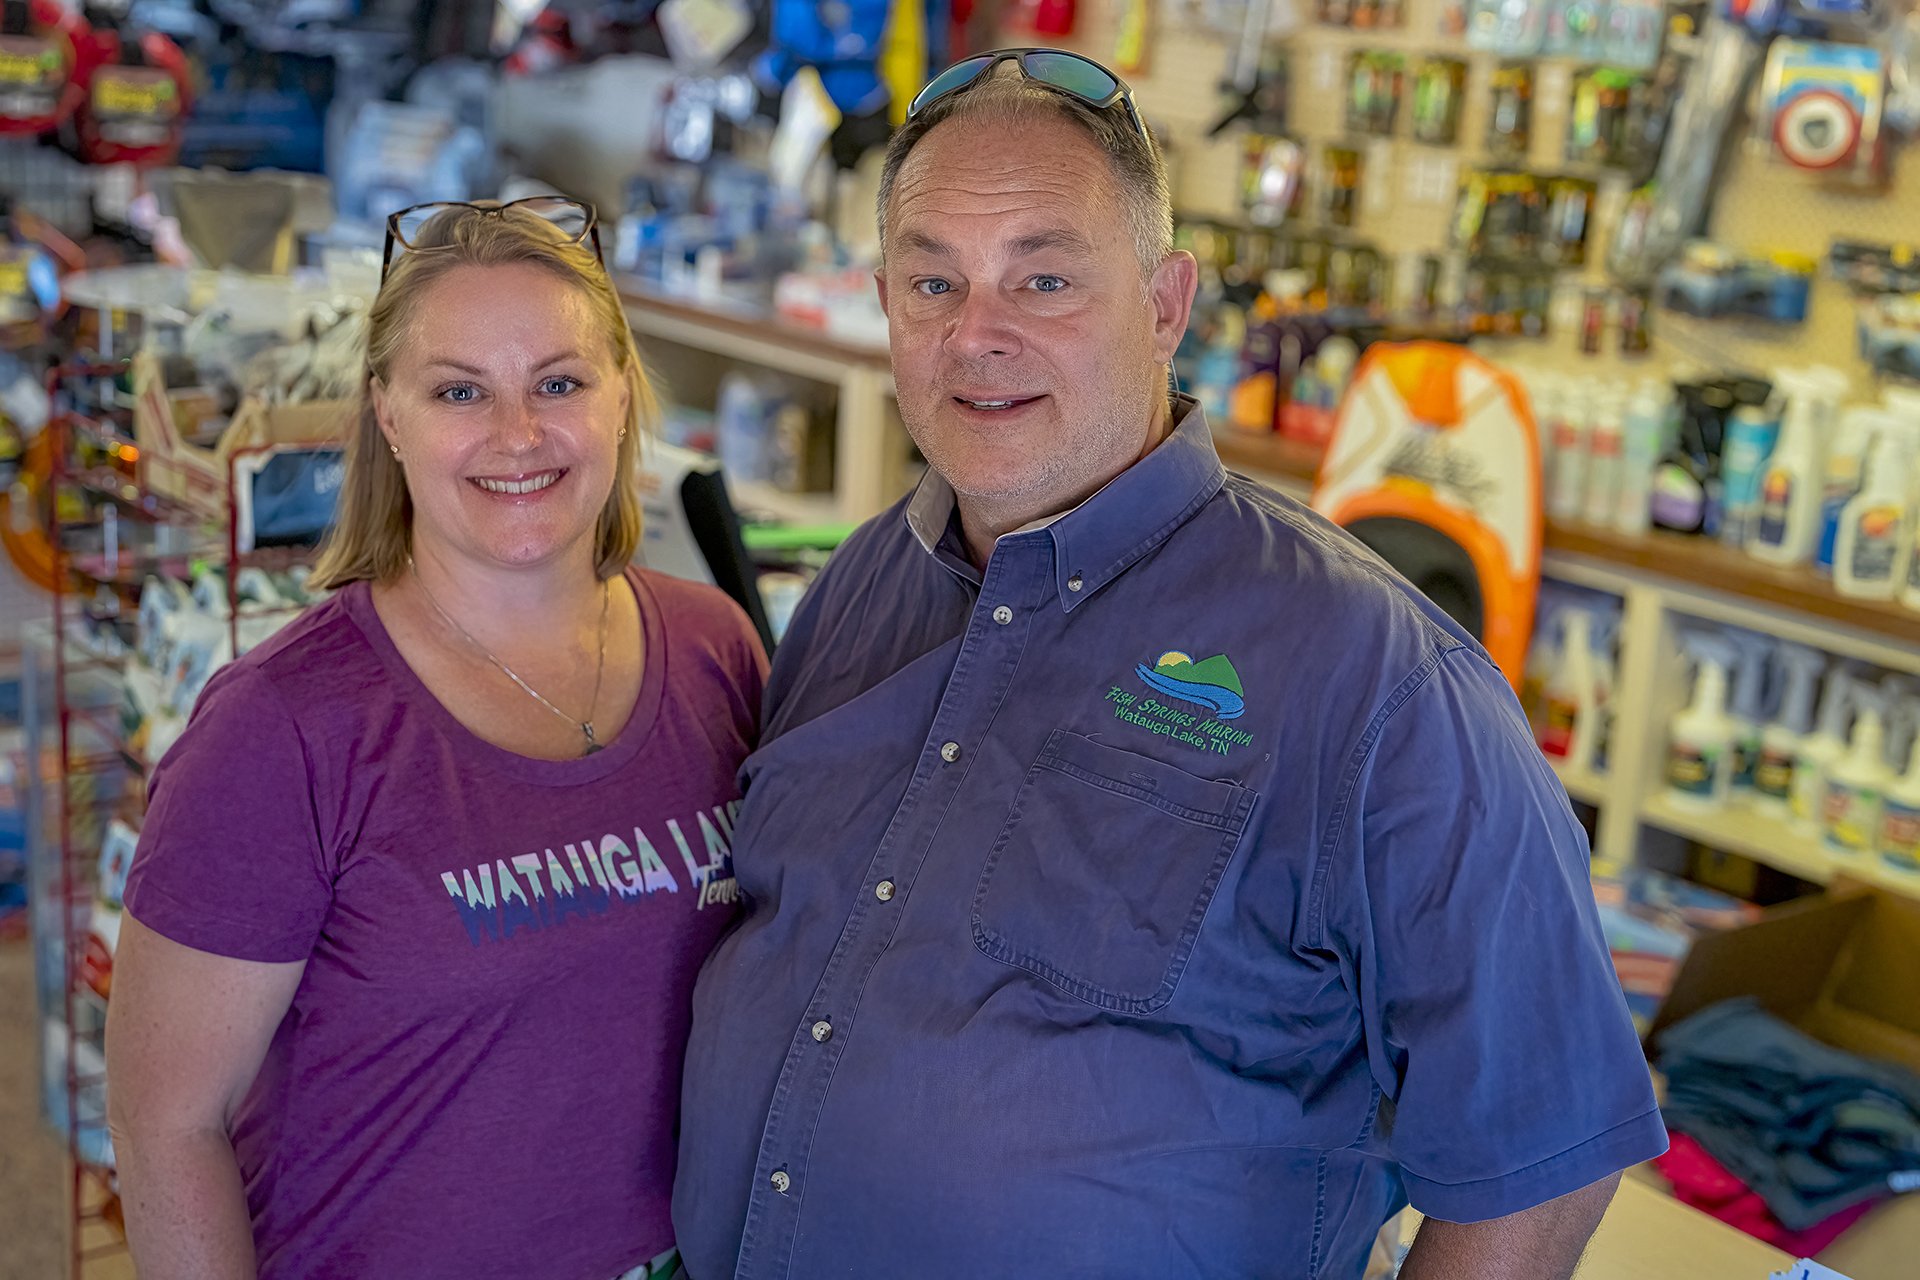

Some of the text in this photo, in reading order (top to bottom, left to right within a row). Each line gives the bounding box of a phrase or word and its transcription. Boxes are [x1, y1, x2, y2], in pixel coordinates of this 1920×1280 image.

[1105, 684, 1254, 747] FISH SPRINGS MARINA
[1114, 705, 1231, 756] Watauga Lake, TN
[440, 826, 679, 946] WATAUGA
[697, 863, 743, 911] Tenn
